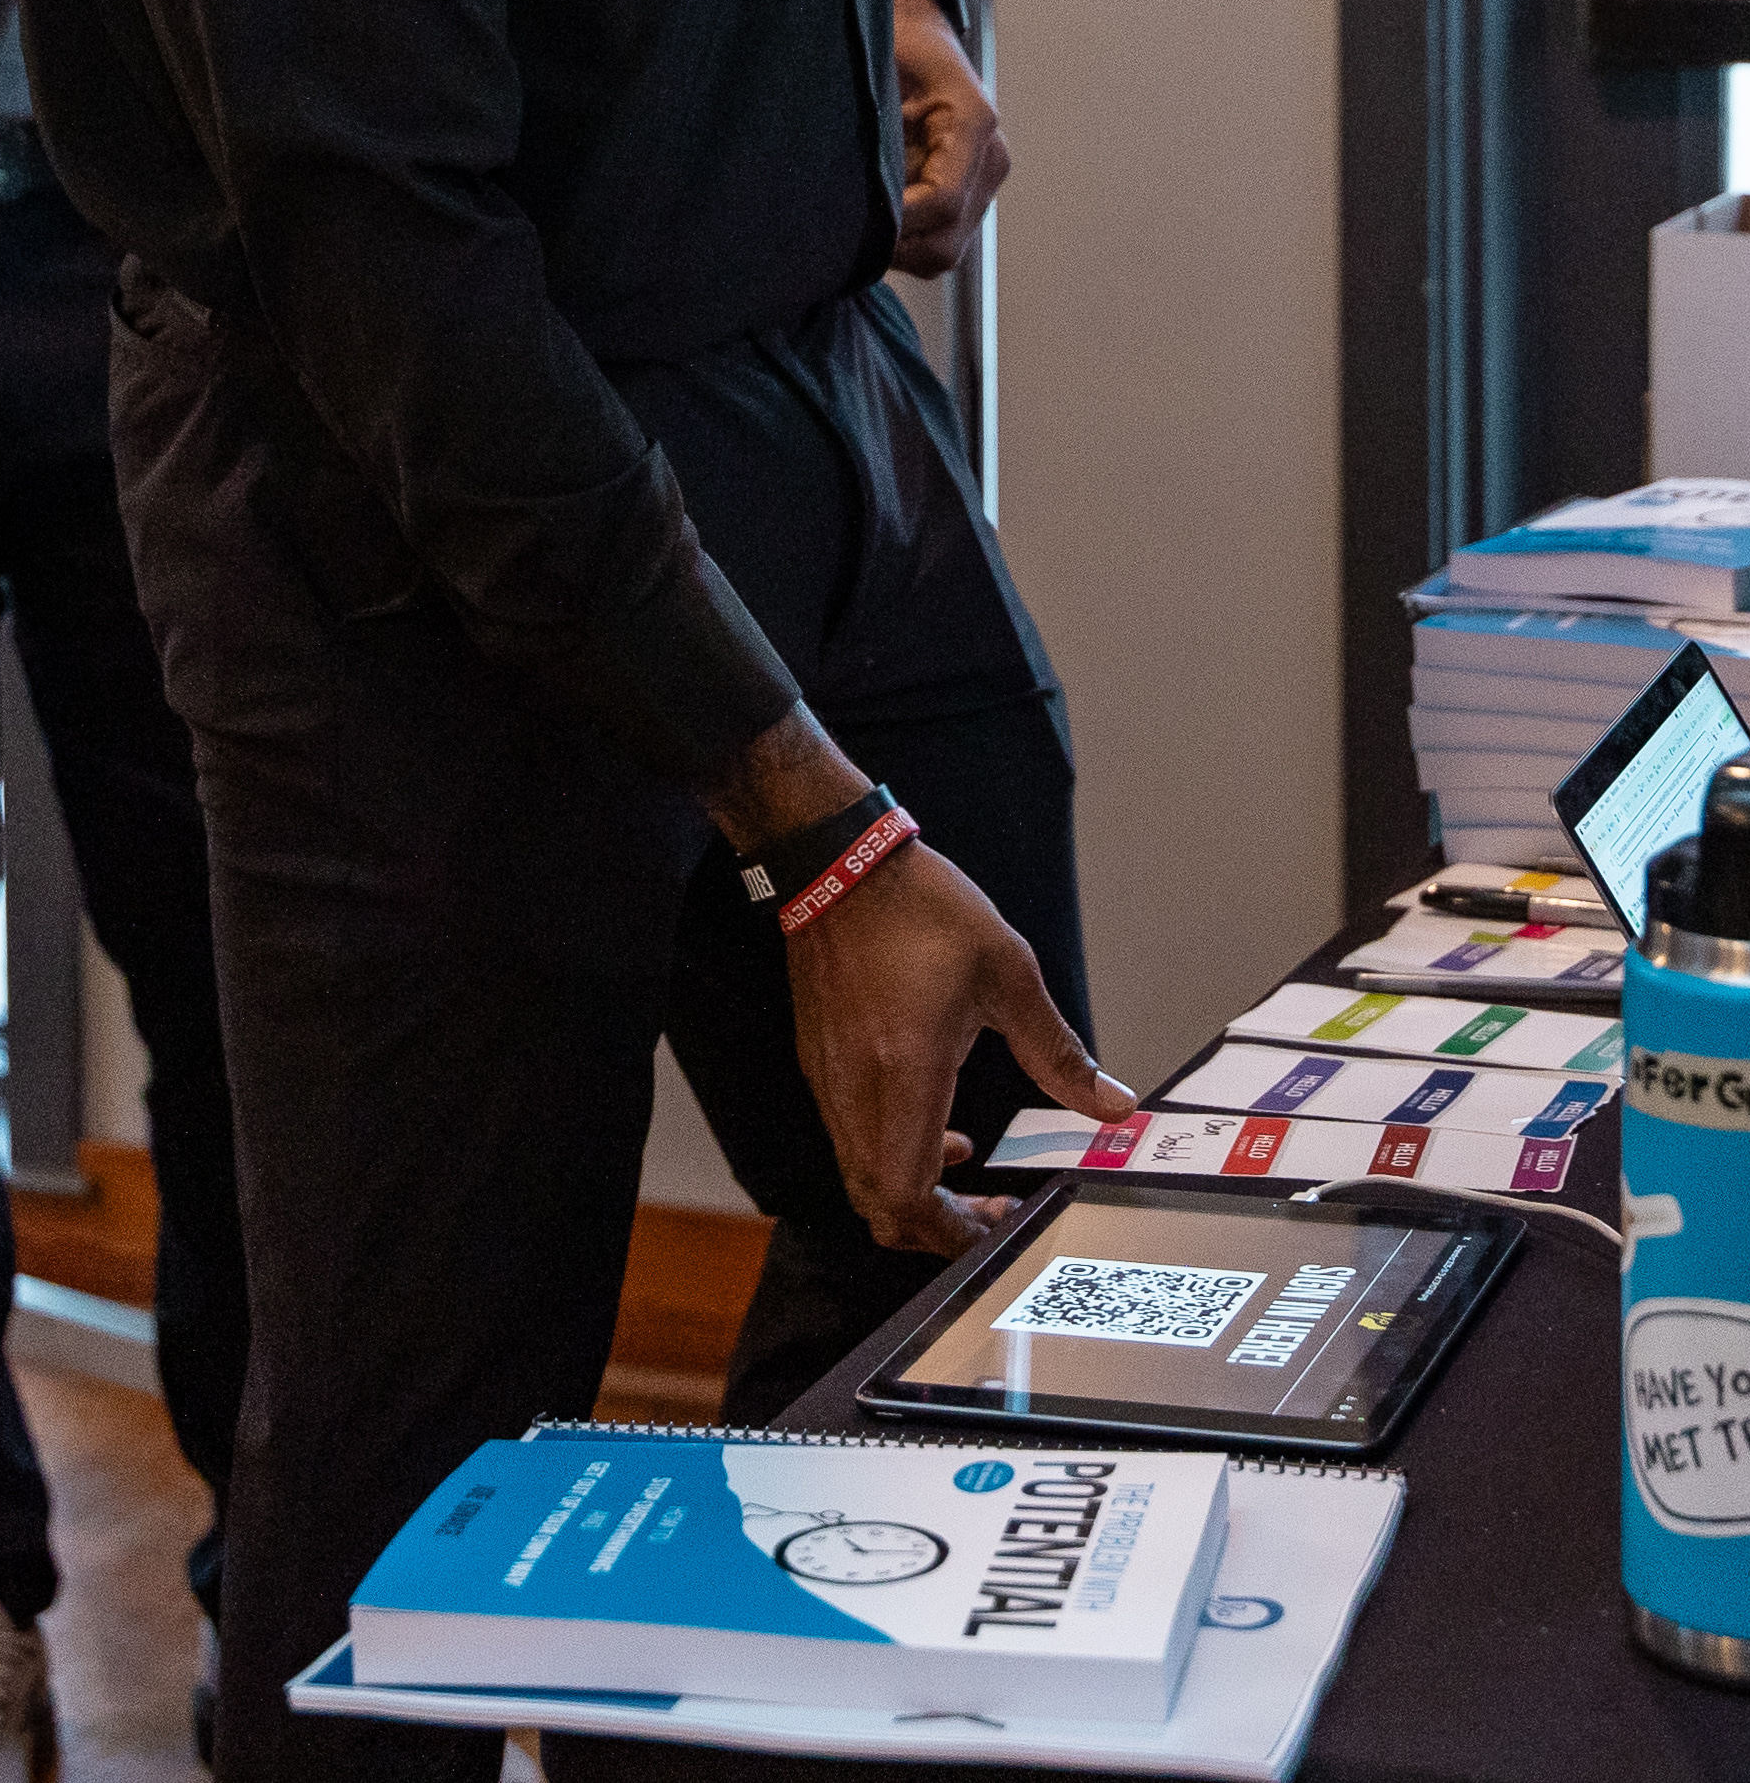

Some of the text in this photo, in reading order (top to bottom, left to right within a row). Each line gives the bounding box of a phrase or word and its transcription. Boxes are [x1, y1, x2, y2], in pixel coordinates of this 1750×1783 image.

[844, 810, 916, 875] ONFESS
[1282, 1074, 1323, 1097] HELLO
[1414, 1088, 1455, 1112] HELLO
[1246, 1134, 1276, 1159] HELLO
[1388, 1142, 1417, 1167] HELLO
[1533, 1148, 1563, 1172] HELLO
[1225, 1263, 1358, 1368] SIGN IN HERE!
[1633, 1368, 1704, 1410] HAVE
[1642, 1424, 1703, 1473] MET
[959, 1461, 1117, 1641] POTENTIAL
[1073, 1482, 1154, 1611] THE PROBLEM WITH
